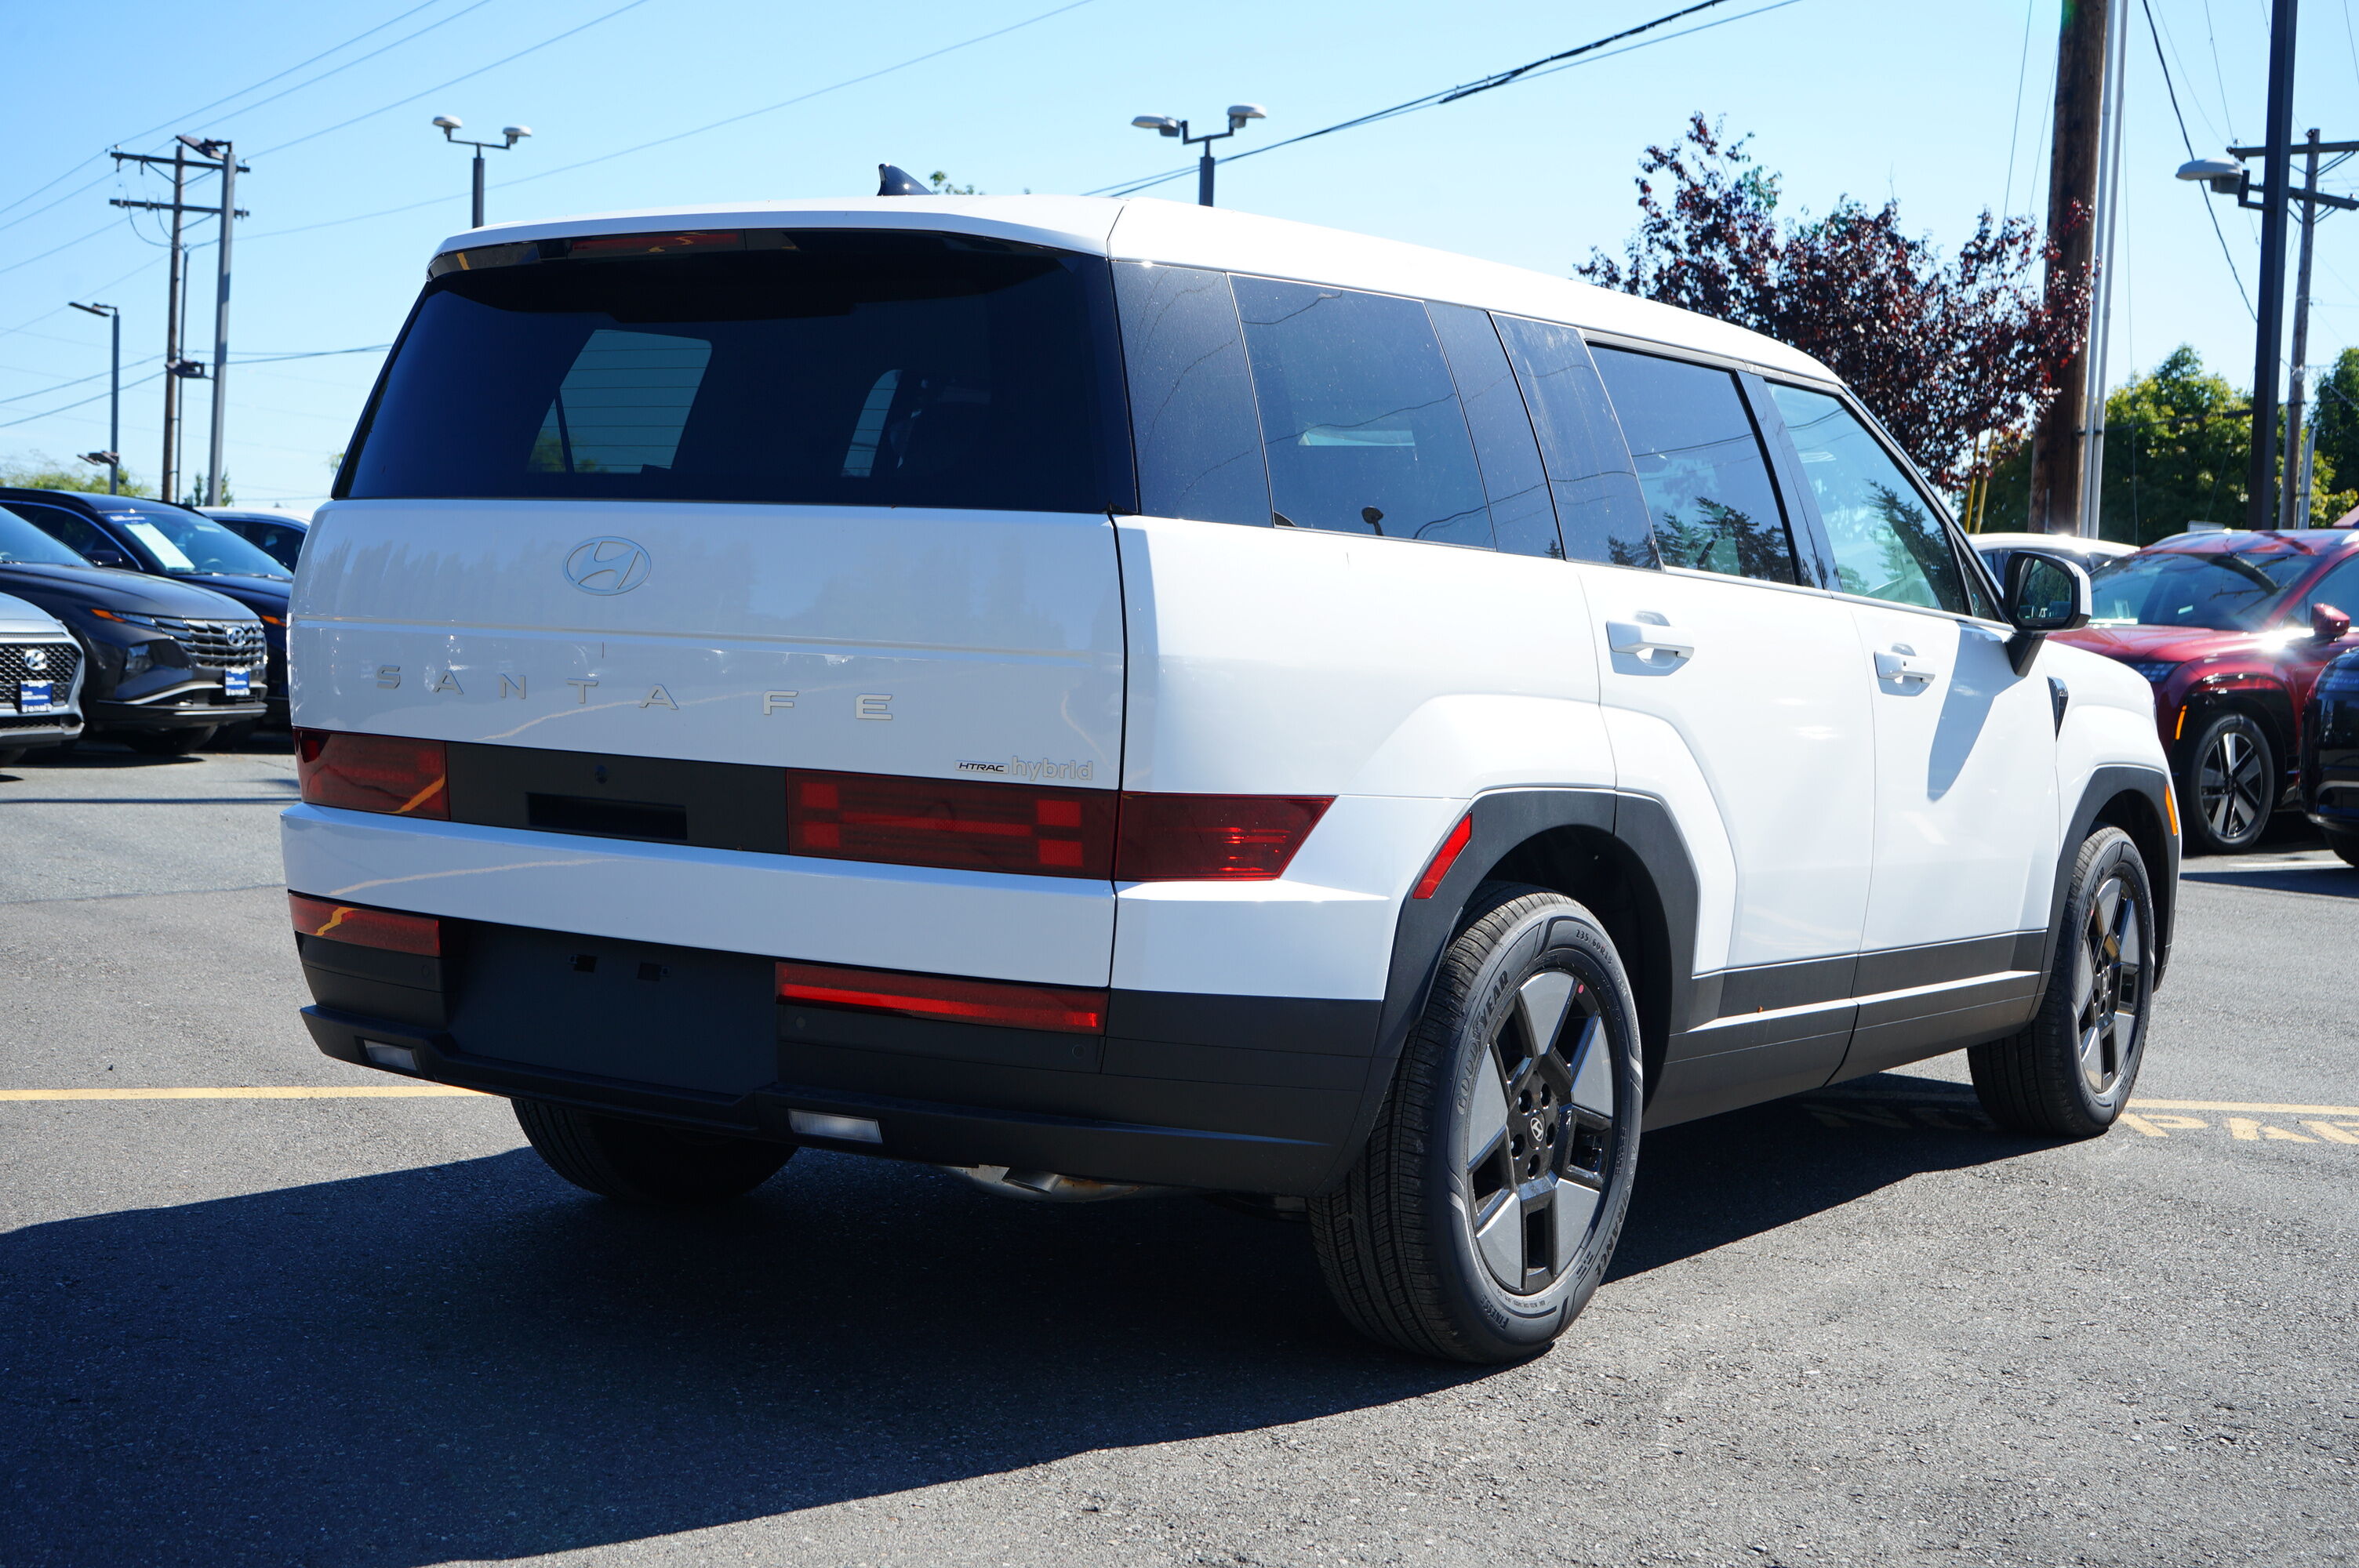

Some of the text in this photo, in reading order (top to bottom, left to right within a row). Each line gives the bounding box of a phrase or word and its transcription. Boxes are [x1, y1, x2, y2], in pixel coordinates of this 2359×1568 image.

[376, 664, 893, 720] SANTA FE
[958, 755, 1093, 781] HTRAC hybrid
[1575, 929, 1613, 965] 235/60R18
[1456, 970, 1510, 1115] GOODYEAR
